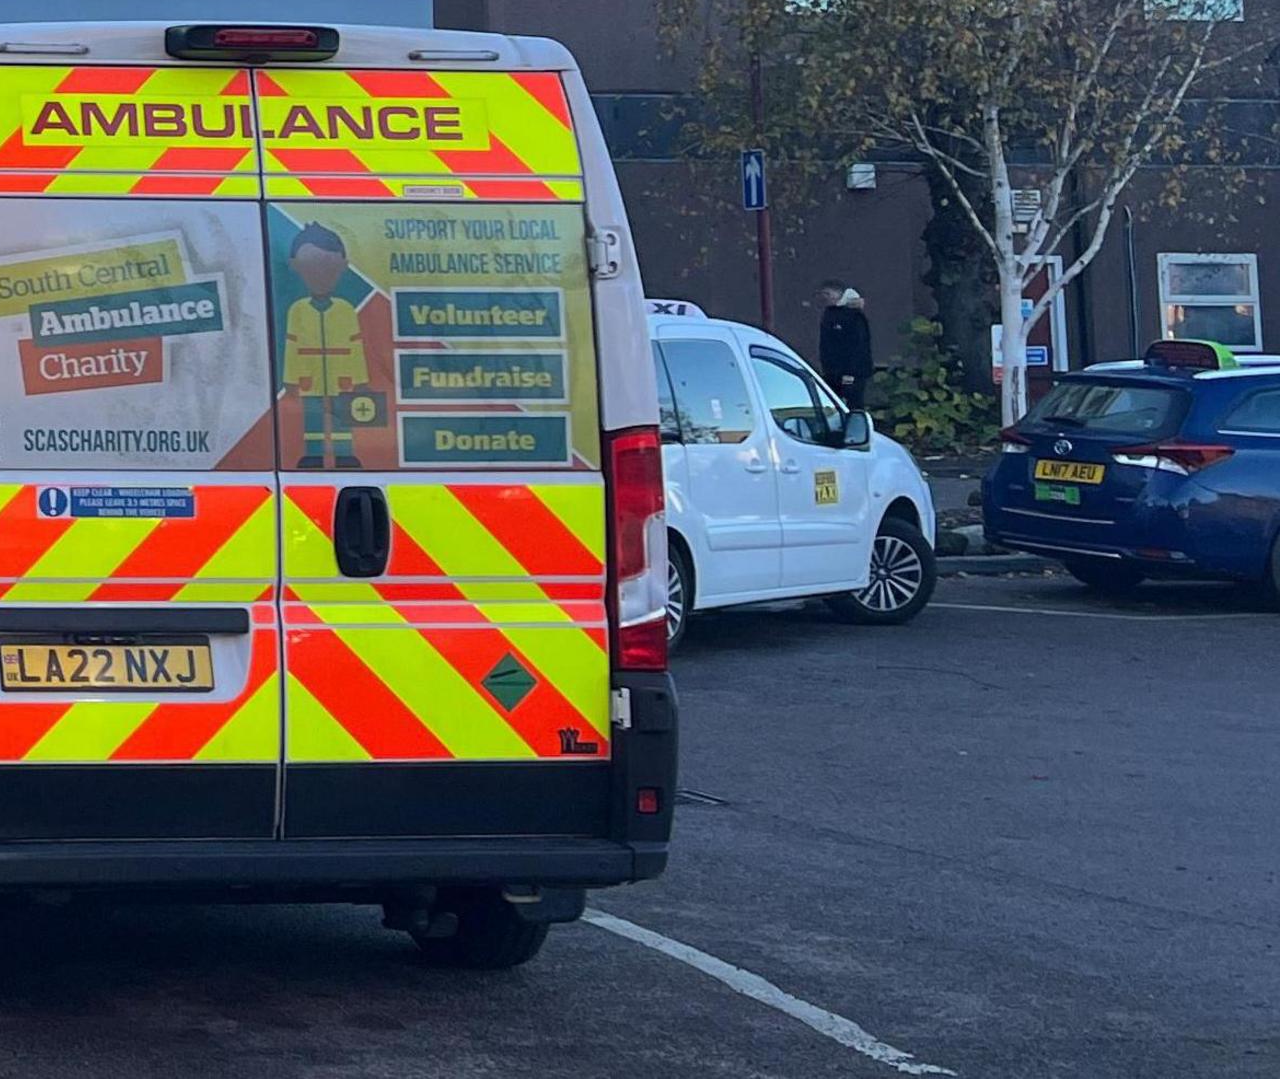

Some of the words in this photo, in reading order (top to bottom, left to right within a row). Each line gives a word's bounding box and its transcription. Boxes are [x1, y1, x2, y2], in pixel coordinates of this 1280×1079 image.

[31, 101, 463, 140] AMBULANCE
[384, 219, 457, 240] SUPPORT
[463, 219, 505, 241] YOUR
[509, 220, 560, 241] LOCAL
[78, 254, 170, 287] Central
[389, 252, 489, 274] AMBULANCE
[494, 253, 562, 274] SERVICE
[40, 298, 215, 337] Ambulance
[410, 304, 547, 326] Volunteer
[652, 303, 687, 316] XI
[40, 348, 148, 381] Charity
[413, 366, 553, 388] Fundraise
[24, 429, 210, 453] SCASCHARITY.ORG.UK
[435, 429, 536, 451] Donate
[17, 649, 116, 683] LA22
[125, 649, 196, 683] NXJ
